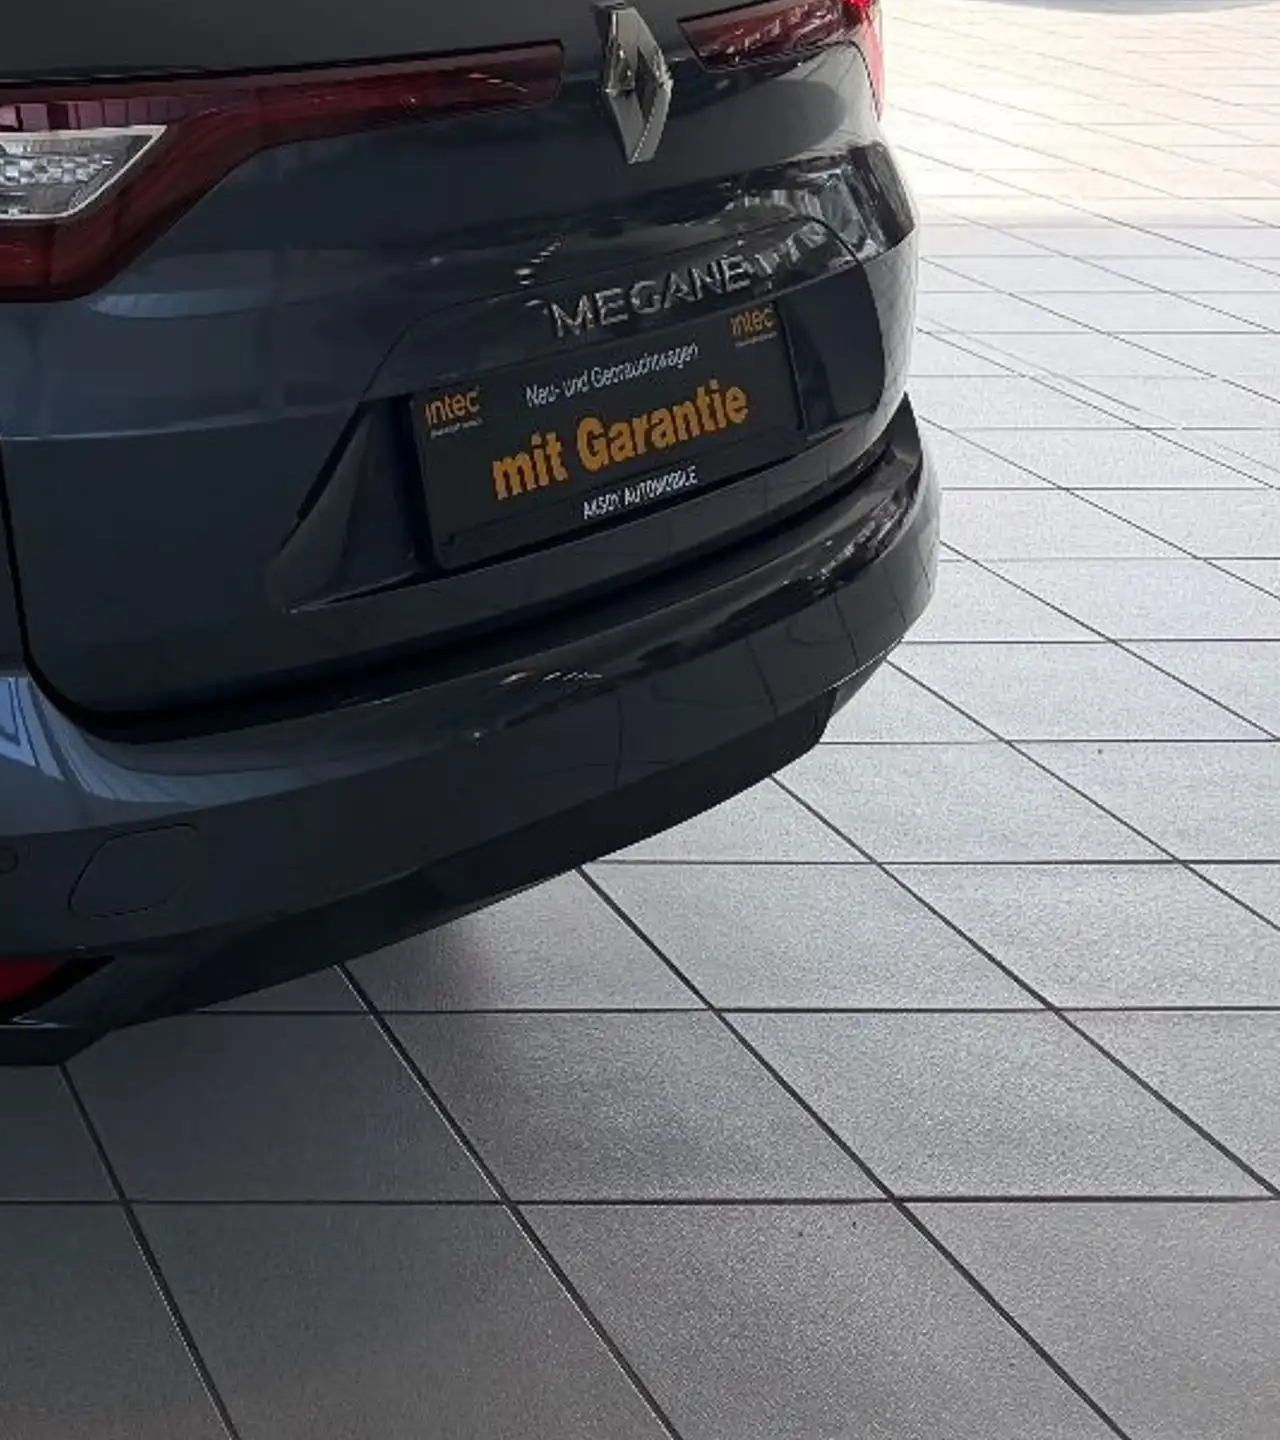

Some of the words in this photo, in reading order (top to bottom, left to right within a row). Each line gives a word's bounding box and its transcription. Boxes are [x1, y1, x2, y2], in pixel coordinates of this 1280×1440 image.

[546, 254, 751, 339] MEGANE
[562, 369, 589, 398] und
[492, 430, 568, 500] mit
[576, 378, 749, 473] Garantie
